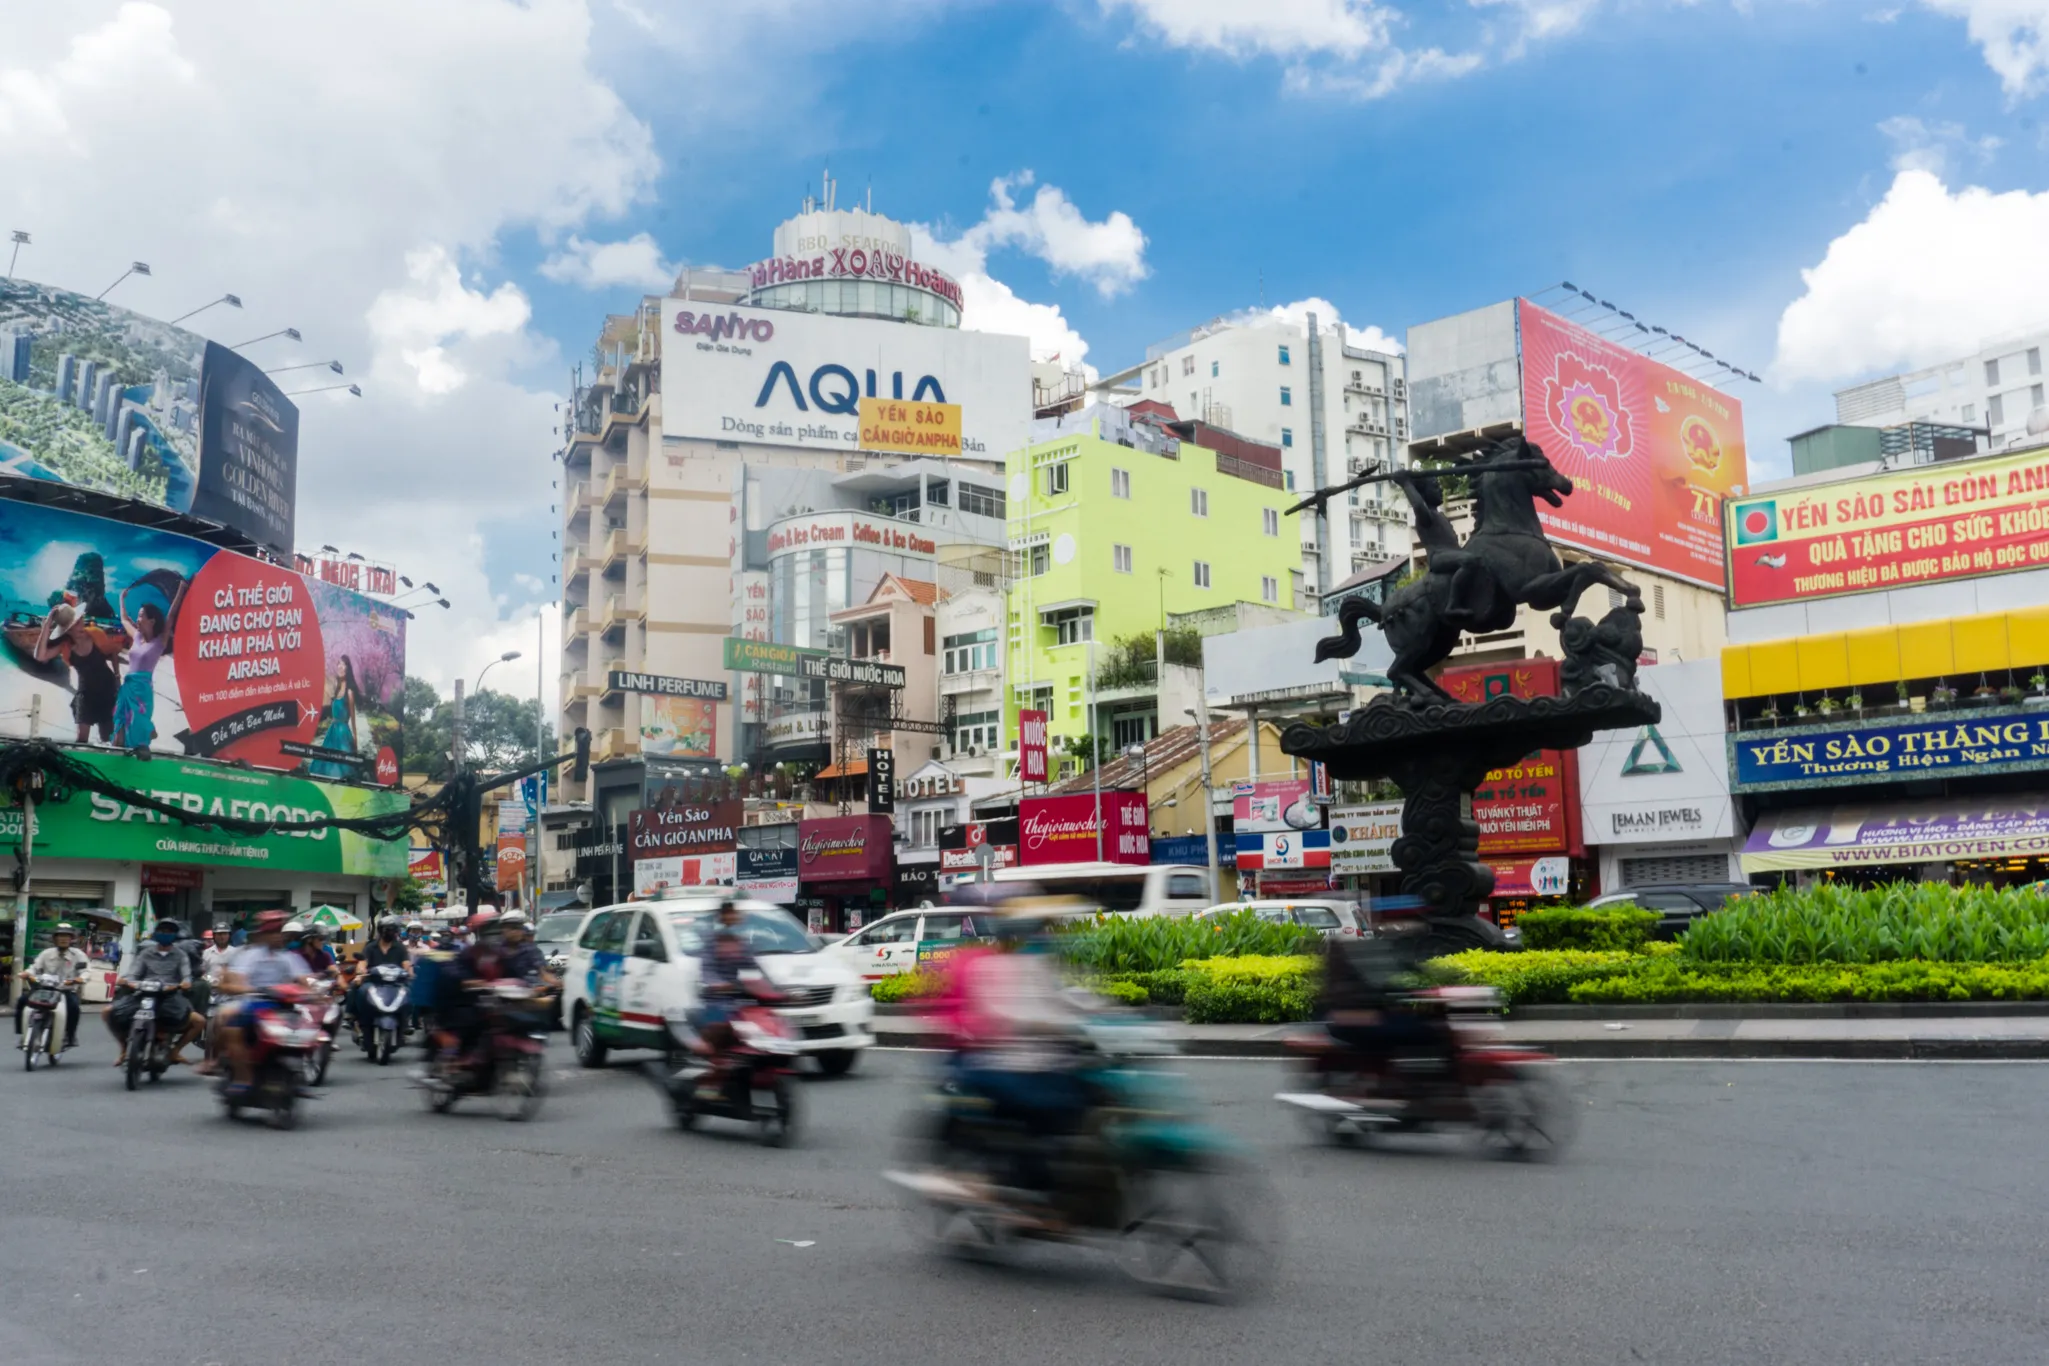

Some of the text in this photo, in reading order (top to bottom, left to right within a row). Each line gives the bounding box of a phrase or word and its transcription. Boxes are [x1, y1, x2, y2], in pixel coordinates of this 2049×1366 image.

[798, 235, 828, 251] BBQ
[768, 255, 824, 285] Hàng
[829, 248, 904, 283] XOAY
[674, 311, 774, 342] SANYO
[755, 360, 947, 416] AQUA
[877, 405, 944, 425] YẾN SÀO
[722, 416, 764, 438] Dòng
[798, 424, 839, 442] phẩm
[892, 426, 959, 448] GIỜ ANPHA
[1691, 490, 1714, 517] 71
[1782, 472, 1997, 531] YẾN SÀO SÀI GÒN
[794, 527, 808, 544] Ice
[810, 523, 844, 542] Cream
[852, 522, 935, 554] Coffee & Ice Cream
[1809, 535, 1847, 566] QUÀ
[1851, 531, 1902, 561] TẶNG
[1907, 523, 1947, 549] CHO
[1953, 514, 1994, 543] SỨC
[1793, 572, 1844, 592] THƯƠNG
[1848, 566, 1877, 587] HIỆU
[1880, 562, 1899, 581] ĐÃ
[1902, 558, 1939, 579] ĐƯỢC
[1941, 550, 1970, 573] BẢO
[1973, 547, 1993, 569] HỘ
[1996, 544, 2026, 567] ĐỘC
[214, 580, 293, 608] CẢ THẾ GIỚI
[746, 581, 766, 599] YẾN
[200, 607, 302, 634] ĐANG CHỜ BẠN
[198, 628, 301, 659] KHÁM PHÁ VỚI
[227, 657, 280, 681] AIRASIA
[805, 657, 905, 686] THẾ GIỚI NƯỚC HOA
[215, 690, 227, 701] 100
[619, 673, 723, 697] LINH PERFUME
[211, 706, 285, 746] Đến Nơi Bạn Muốn
[1024, 716, 1046, 746] NƯỚC
[1750, 738, 1815, 766] YẾN
[1825, 734, 1891, 760] SÀO
[1898, 723, 2030, 753] THĂNG
[377, 759, 397, 776] AirAsia
[1027, 750, 1045, 776] HOA
[1506, 762, 1555, 780] TỔ YẾN
[1800, 748, 2020, 774] Thương Hiệu Ngàn
[875, 751, 889, 805] HOTEL
[894, 773, 960, 798] HOTEL
[1520, 782, 1547, 798] YẾN
[657, 808, 709, 825] Yến Sào
[1121, 801, 1133, 826] THẾ
[1476, 803, 1543, 819] TƯ VẤN KỸ THUẬT
[1612, 808, 1702, 835] LEMAN JEWELS
[1349, 821, 1398, 841] KHÁNH
[1499, 817, 1516, 832] YẾN
[1536, 816, 1551, 831] PHÍ
[1862, 827, 1908, 838] HƯƠNG
[1910, 827, 1921, 836] VỊ
[1923, 824, 1949, 833] MỚI
[1996, 818, 2023, 829] CẤP
[156, 837, 177, 851] CỬA
[635, 826, 733, 848] CẦN GIỜ ANPHA
[1119, 830, 1149, 854] NƯỚC HOA
[1832, 836, 2049, 863] WWW.BIATOYEN.CO
[578, 846, 593, 857] LINH
[1168, 846, 1188, 857] KHU
